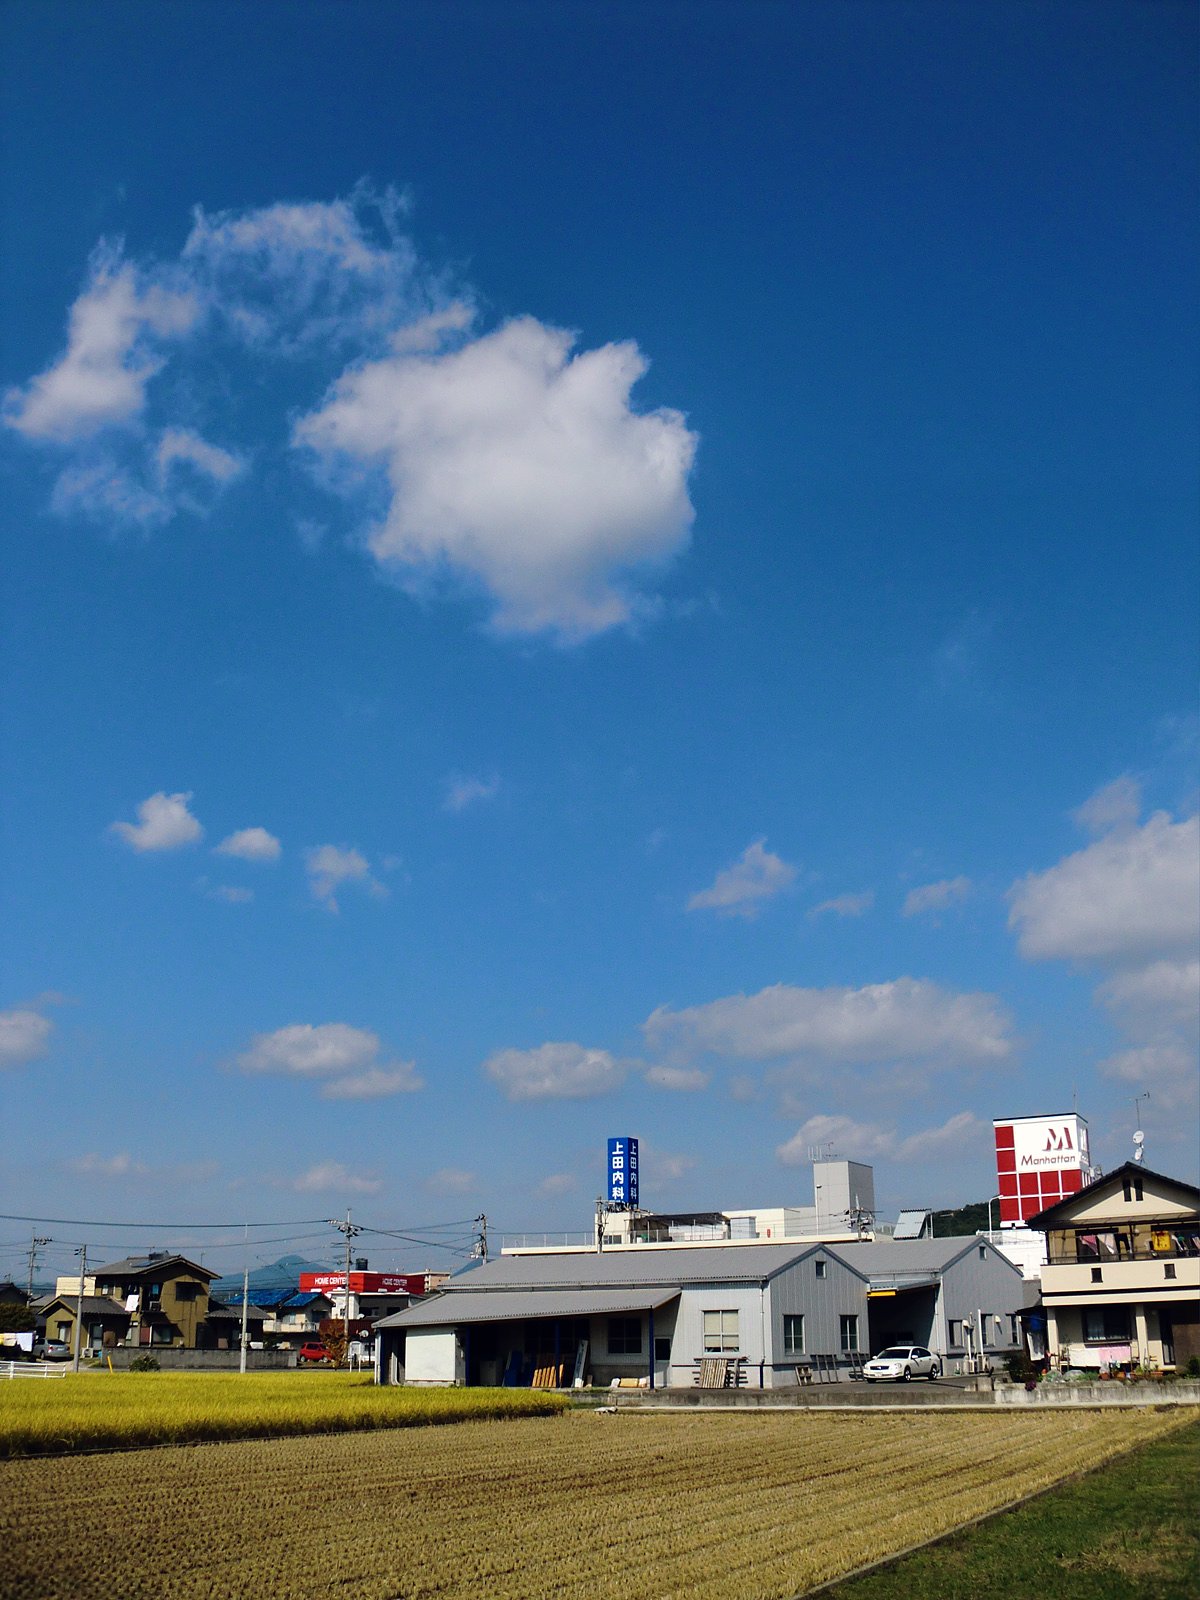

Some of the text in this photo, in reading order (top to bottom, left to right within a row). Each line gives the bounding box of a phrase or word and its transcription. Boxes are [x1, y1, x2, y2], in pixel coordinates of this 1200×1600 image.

[1021, 1155, 1076, 1166] Manhattan
[612, 1141, 624, 1200] 上田内科
[314, 1277, 347, 1285] HOME CENTE
